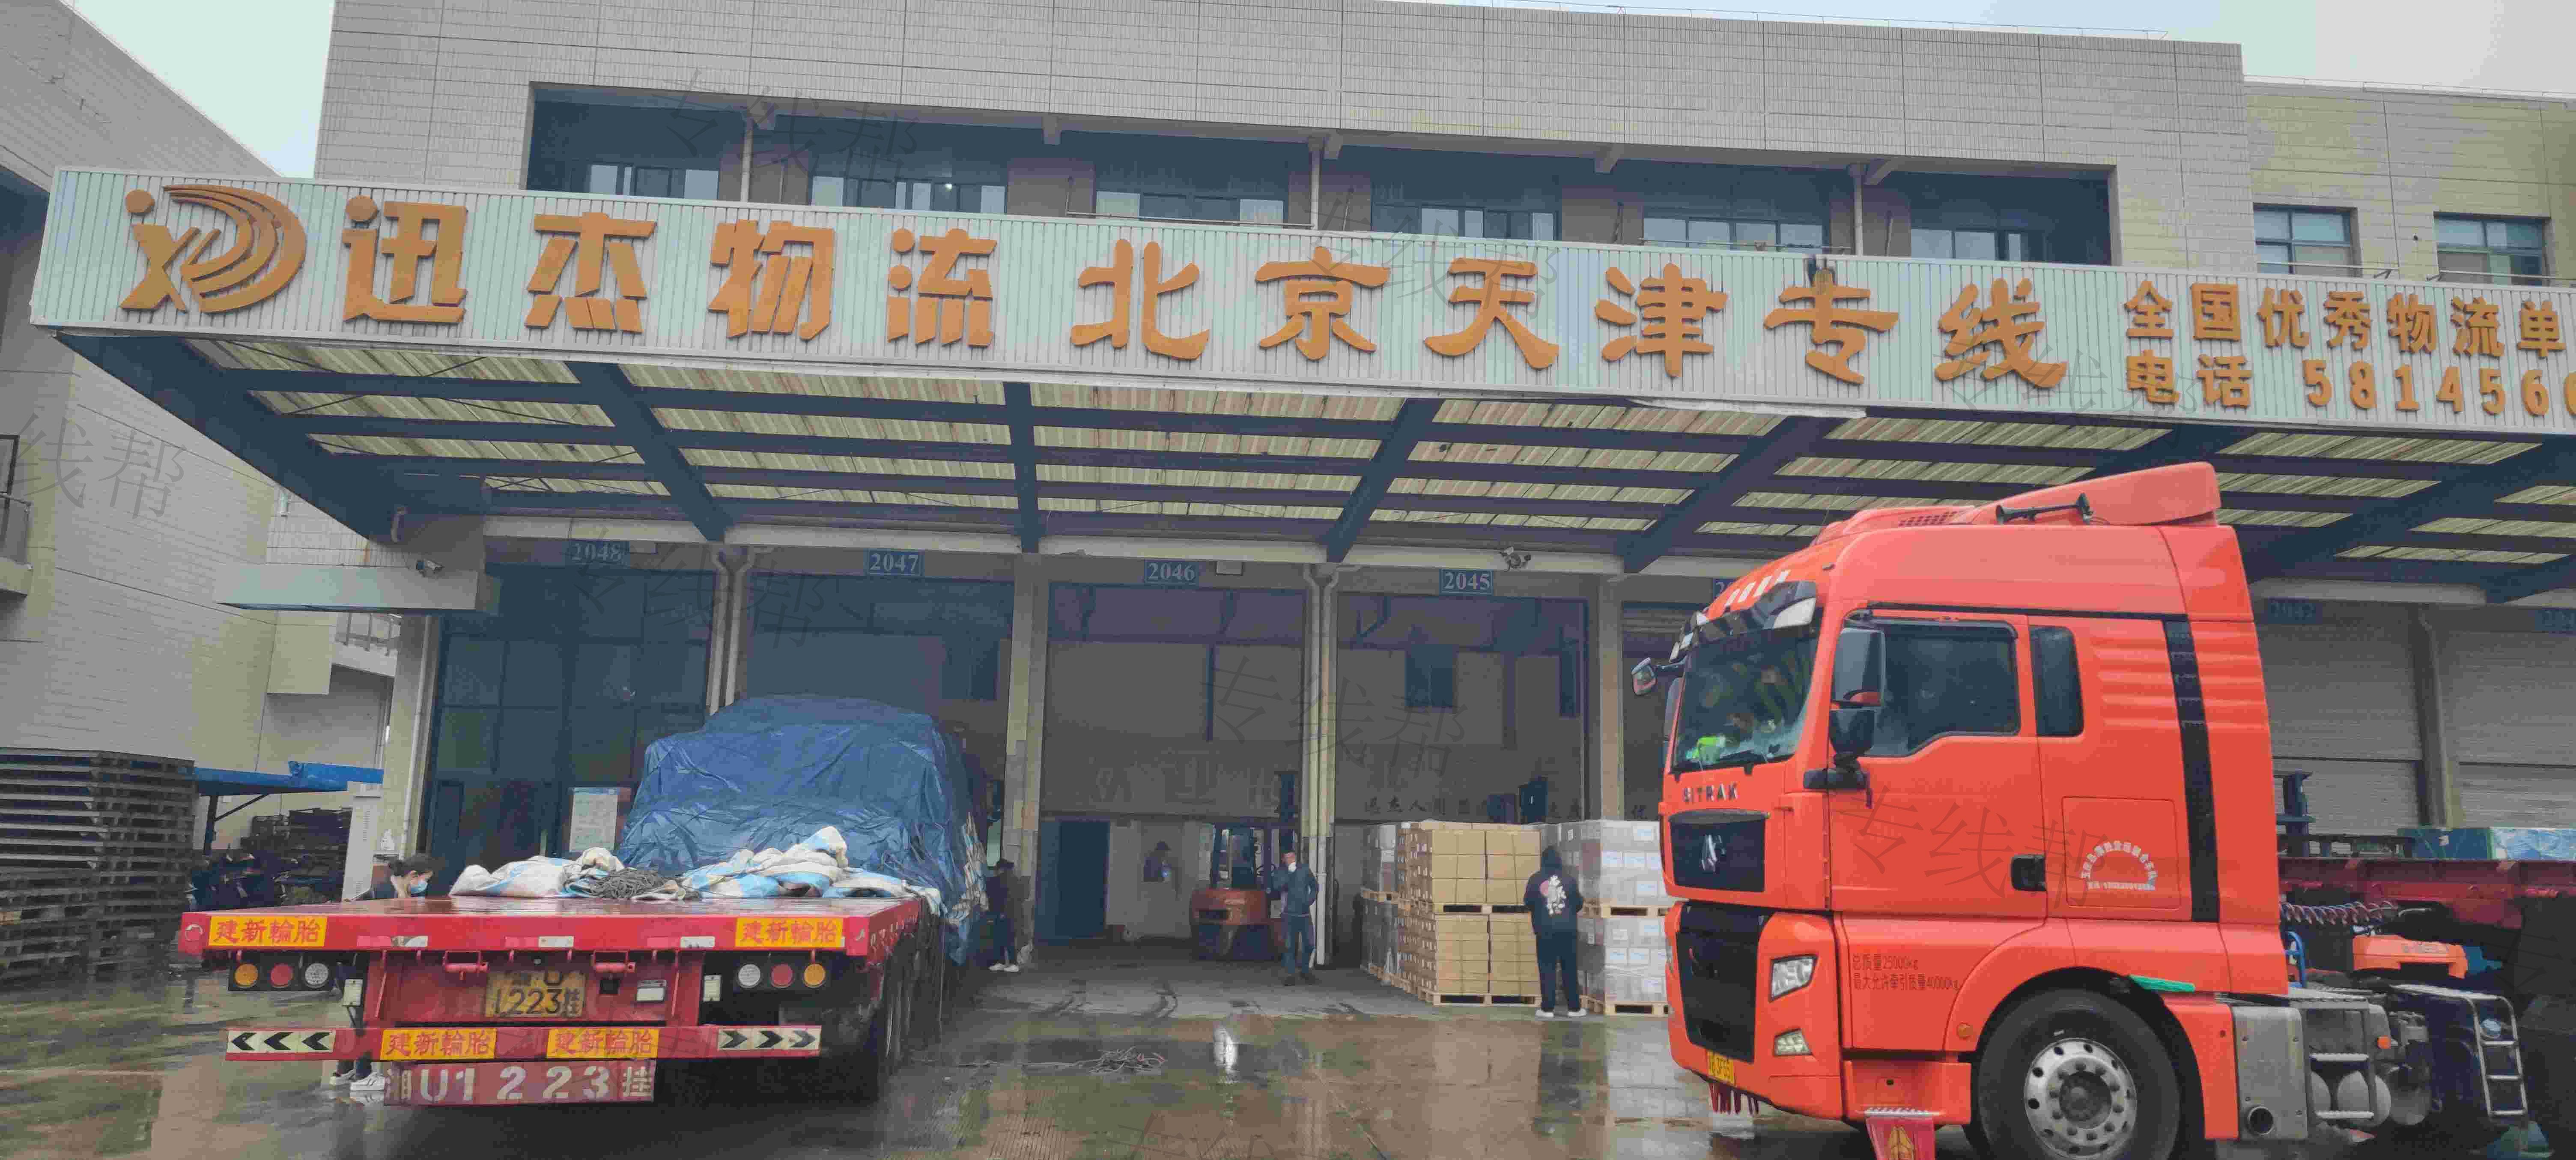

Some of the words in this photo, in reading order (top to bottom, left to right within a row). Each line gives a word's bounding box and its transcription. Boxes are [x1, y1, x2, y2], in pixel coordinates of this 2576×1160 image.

[342, 194, 998, 348] 迅杰物流
[1070, 238, 2068, 388] 北京天津专线
[2125, 280, 2565, 358] 全国优秀物流单
[2126, 349, 2251, 408] 电话
[571, 541, 623, 563] 2048
[869, 553, 919, 573] 2047
[1148, 562, 1195, 583] 2046
[1444, 571, 1491, 592] 2045
[1682, 782, 1740, 803] SITRAK
